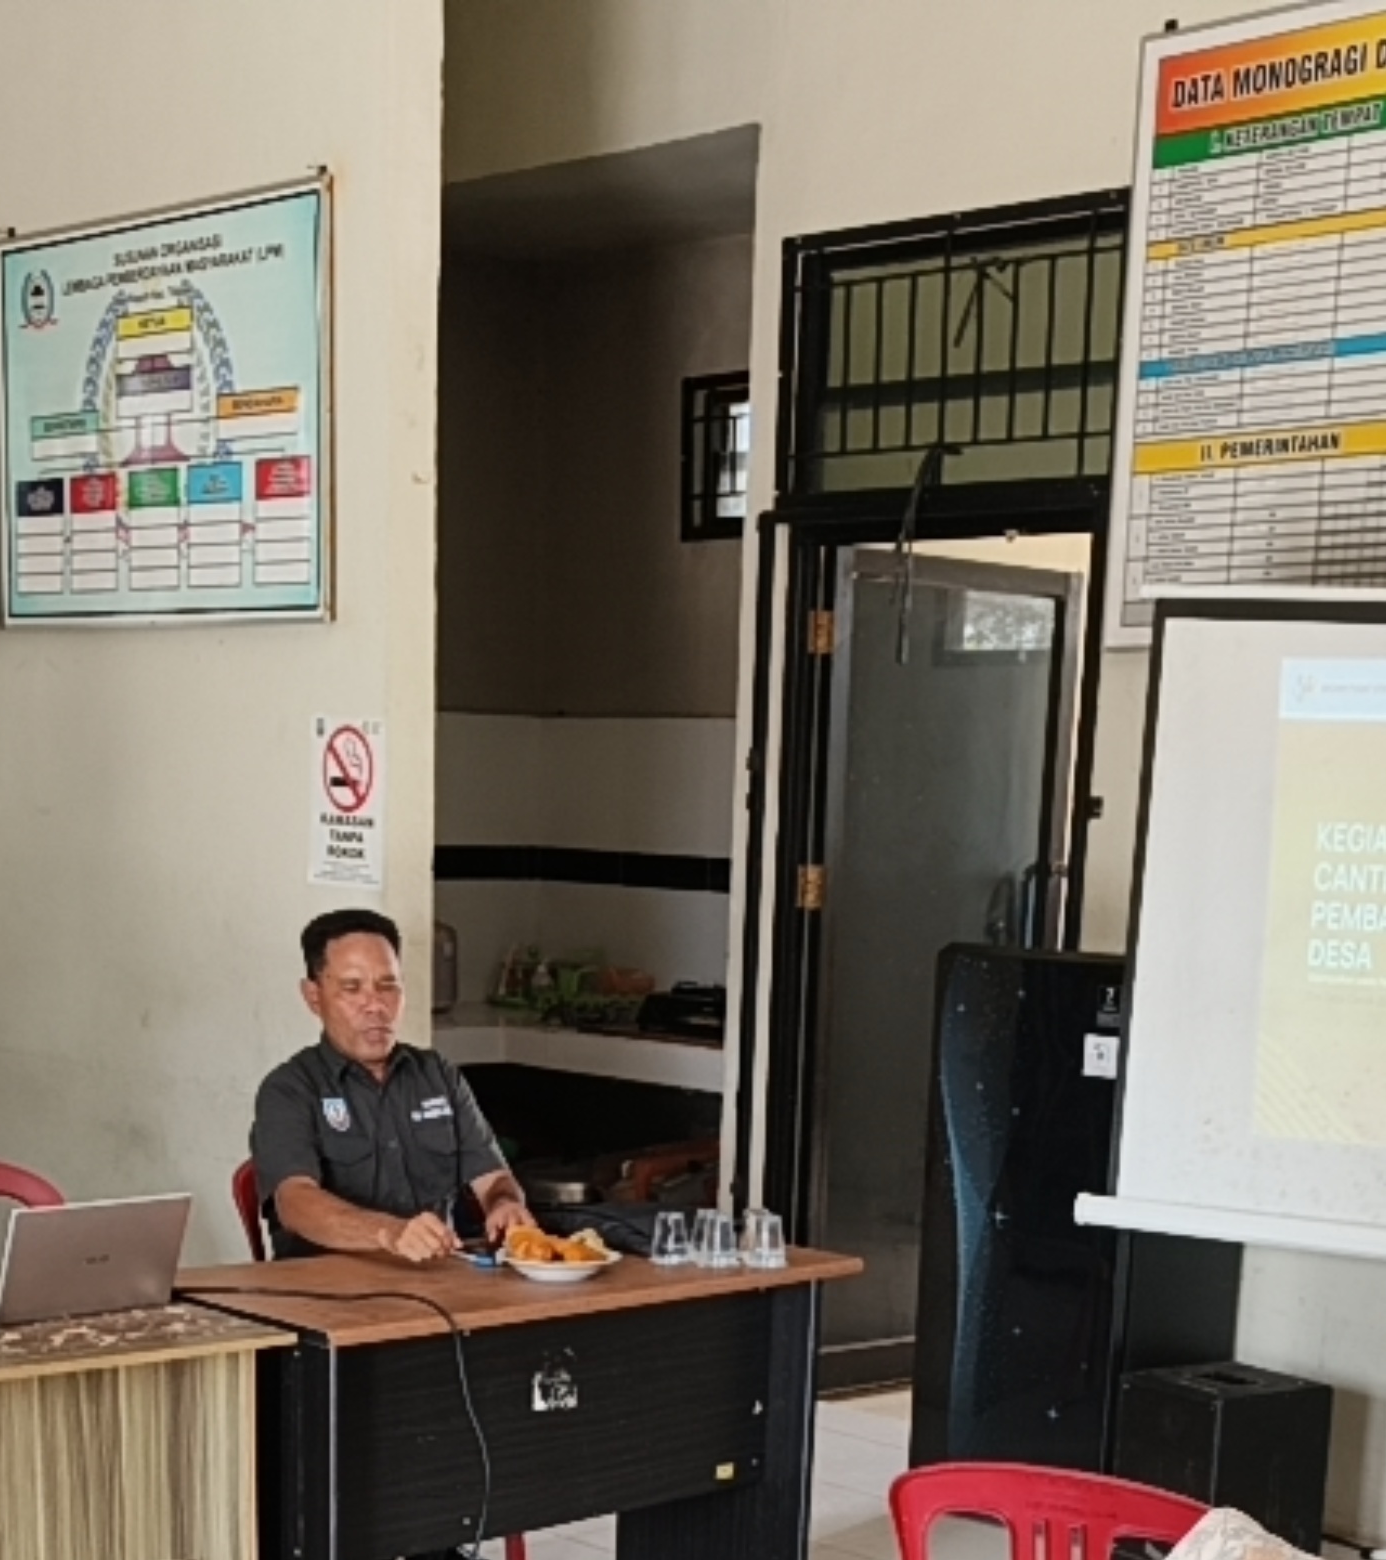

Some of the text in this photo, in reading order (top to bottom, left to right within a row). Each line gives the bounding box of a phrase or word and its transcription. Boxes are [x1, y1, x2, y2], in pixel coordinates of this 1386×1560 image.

[1171, 73, 1225, 109] DATA
[1232, 42, 1368, 98] MONOGRAGI
[1223, 116, 1319, 149] KETERANGAN
[1321, 102, 1384, 133] TEMPAT
[1219, 432, 1342, 460] PEMERINTAHAN
[329, 828, 364, 844] TANPA
[1307, 938, 1373, 970] DESA
